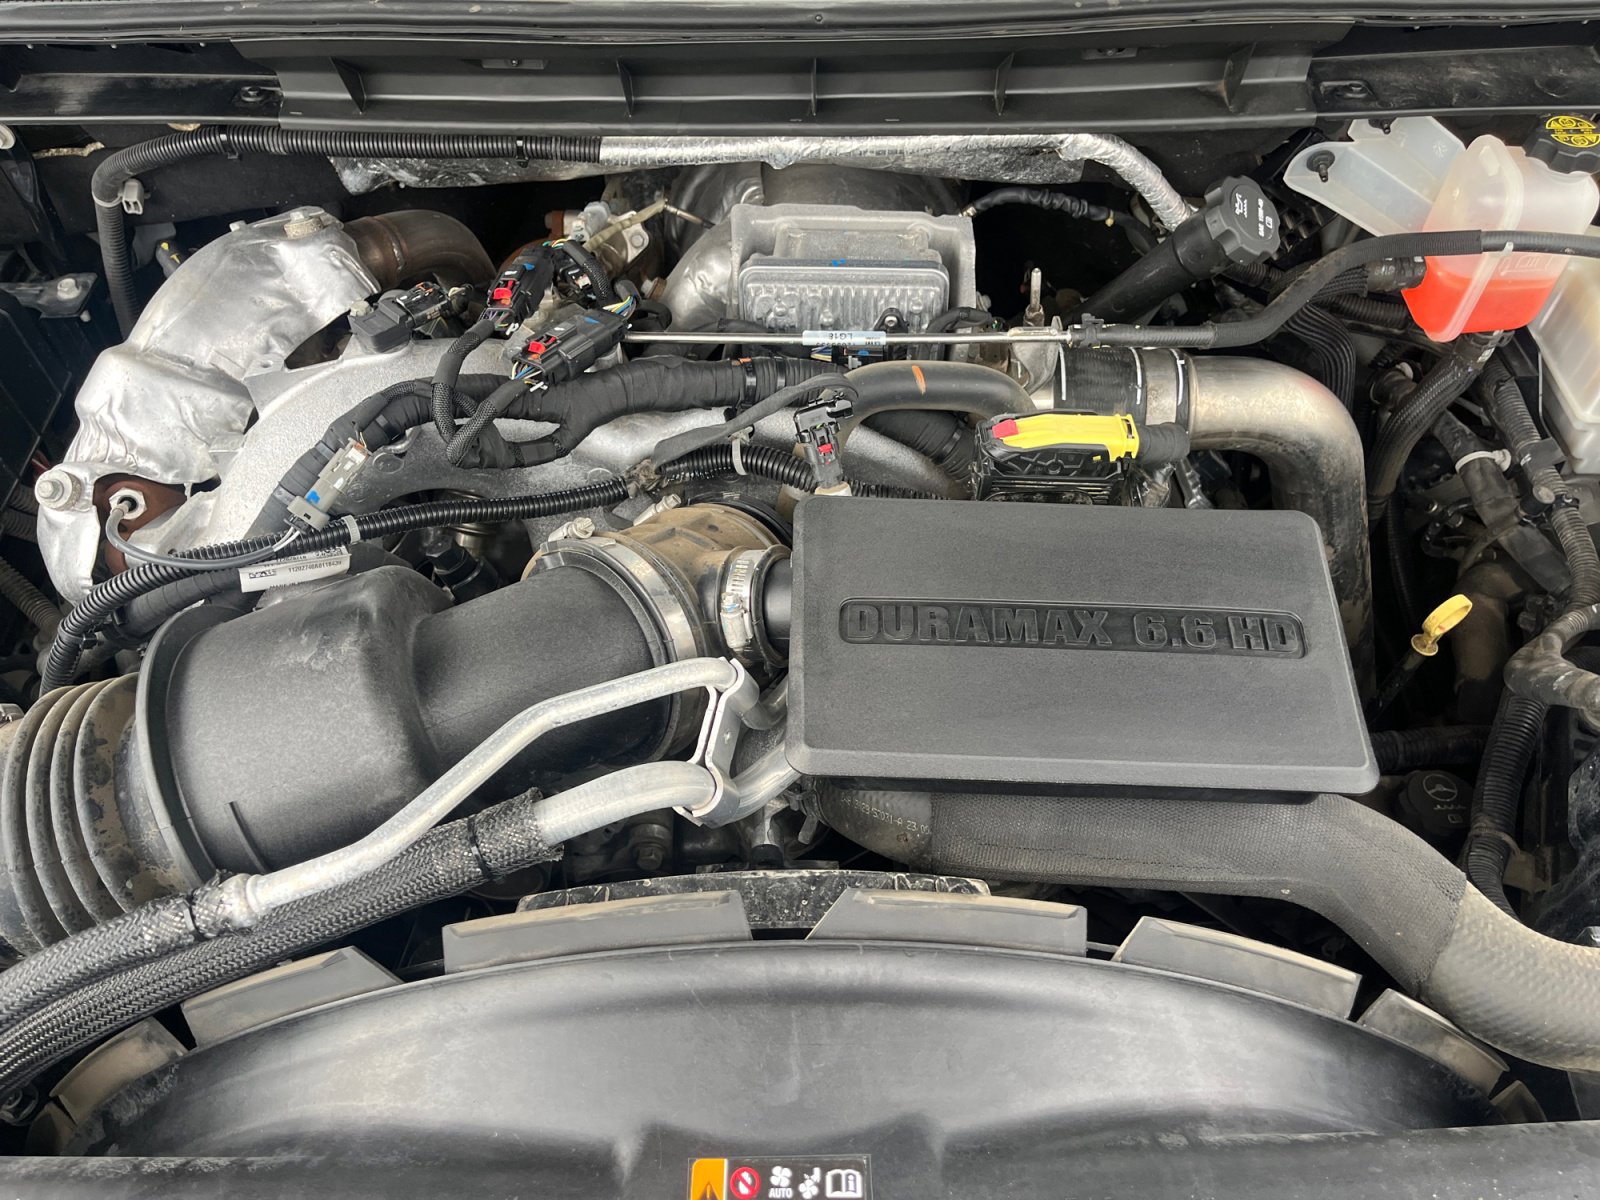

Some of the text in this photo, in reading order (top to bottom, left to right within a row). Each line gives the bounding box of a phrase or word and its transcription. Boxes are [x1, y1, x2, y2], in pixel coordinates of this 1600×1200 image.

[829, 332, 853, 340] LG18
[847, 604, 1300, 653] DURAMAX 6.6 HD
[768, 1187, 793, 1199] AUTO
